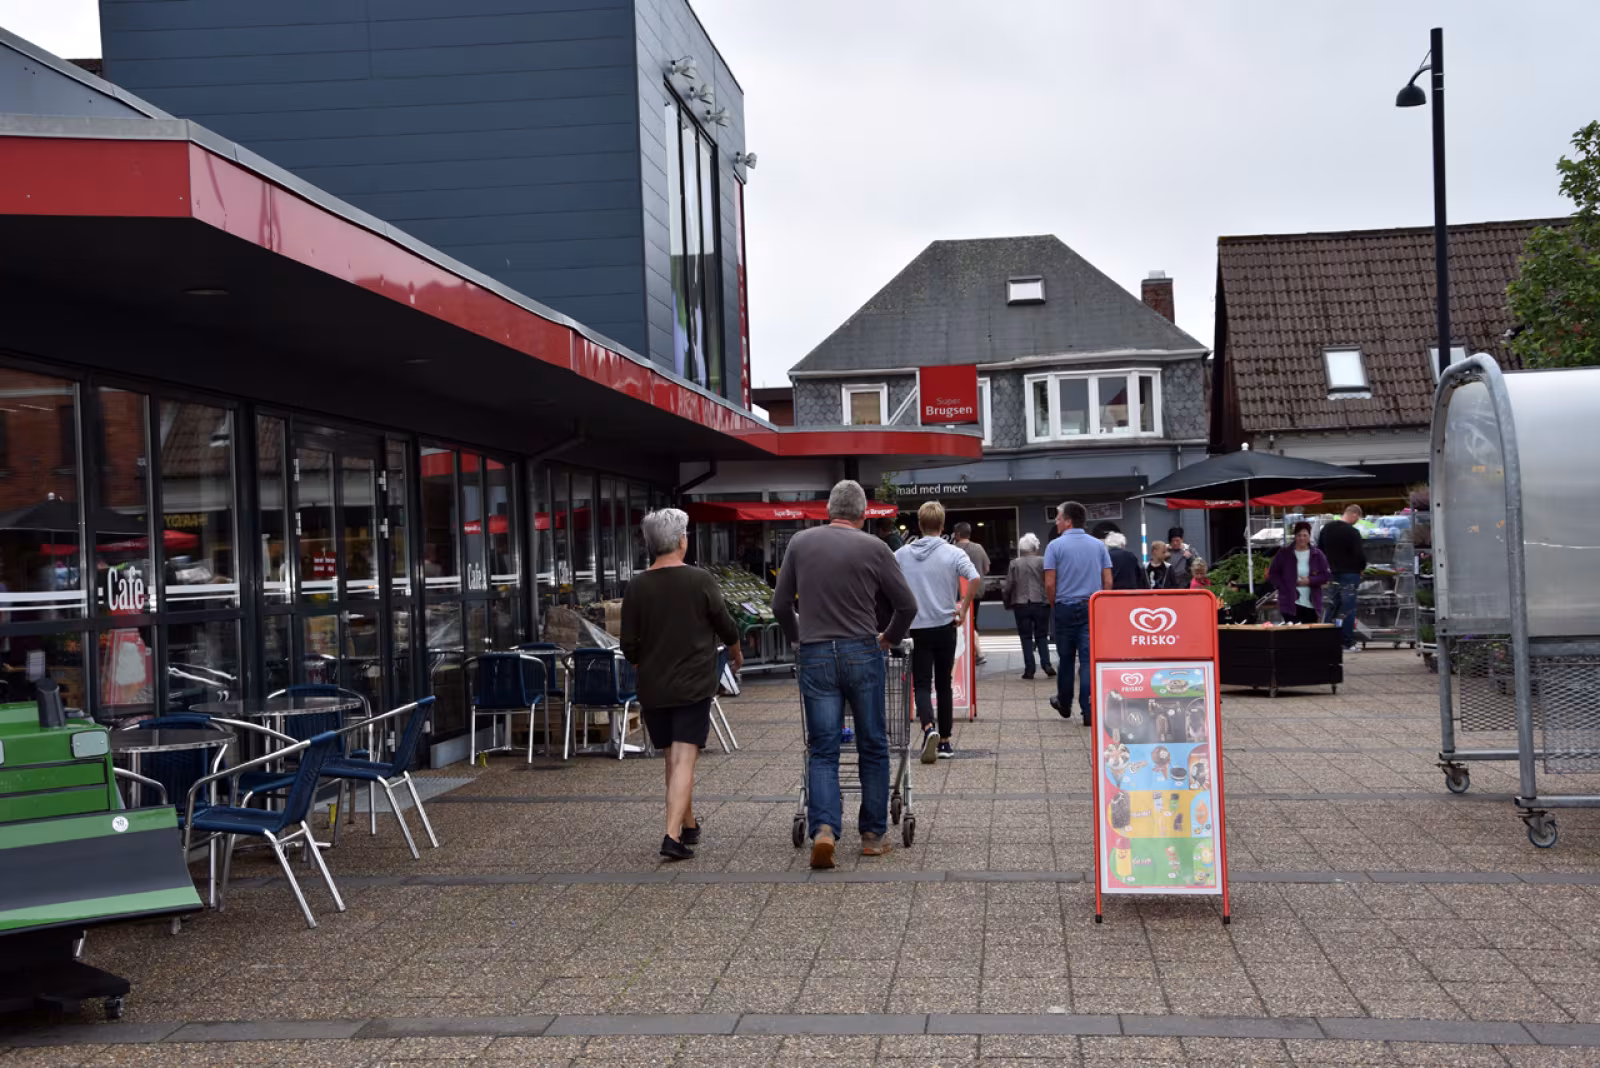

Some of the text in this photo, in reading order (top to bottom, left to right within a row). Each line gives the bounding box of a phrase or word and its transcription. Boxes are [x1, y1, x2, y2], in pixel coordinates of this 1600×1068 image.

[925, 405, 973, 418] Brugsen
[896, 484, 968, 495] mad med mere
[107, 565, 145, 611] Cafe
[1131, 635, 1176, 645] FRISKO
